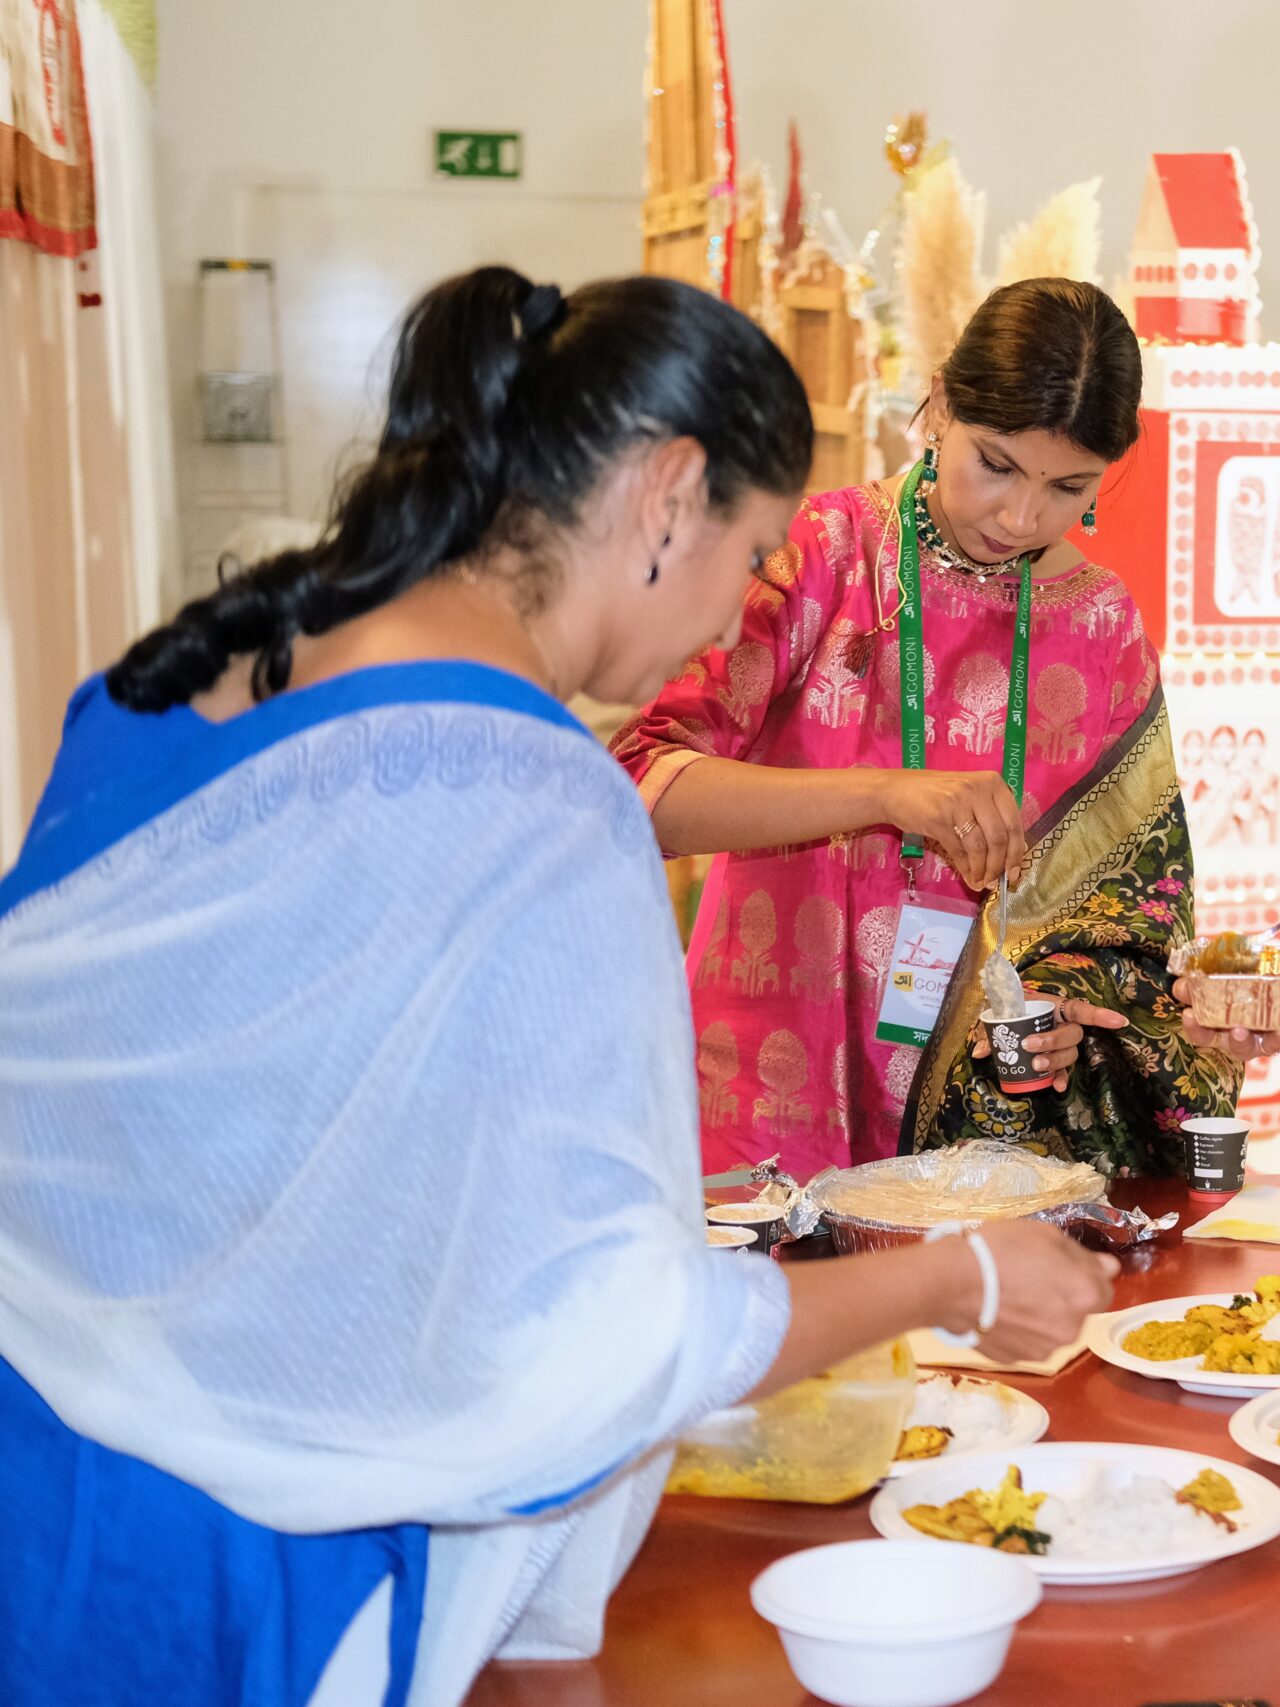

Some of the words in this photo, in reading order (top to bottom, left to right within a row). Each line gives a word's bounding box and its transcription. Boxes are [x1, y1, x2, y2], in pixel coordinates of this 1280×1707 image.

[906, 637, 918, 692] GOMONI
[1014, 655, 1025, 709] GOMONI
[908, 728, 921, 770] OMONI
[914, 977, 947, 993] GOM
[912, 1031, 931, 1044] সদ
[997, 1066, 1008, 1075] TO
[1010, 1066, 1026, 1075] GO
